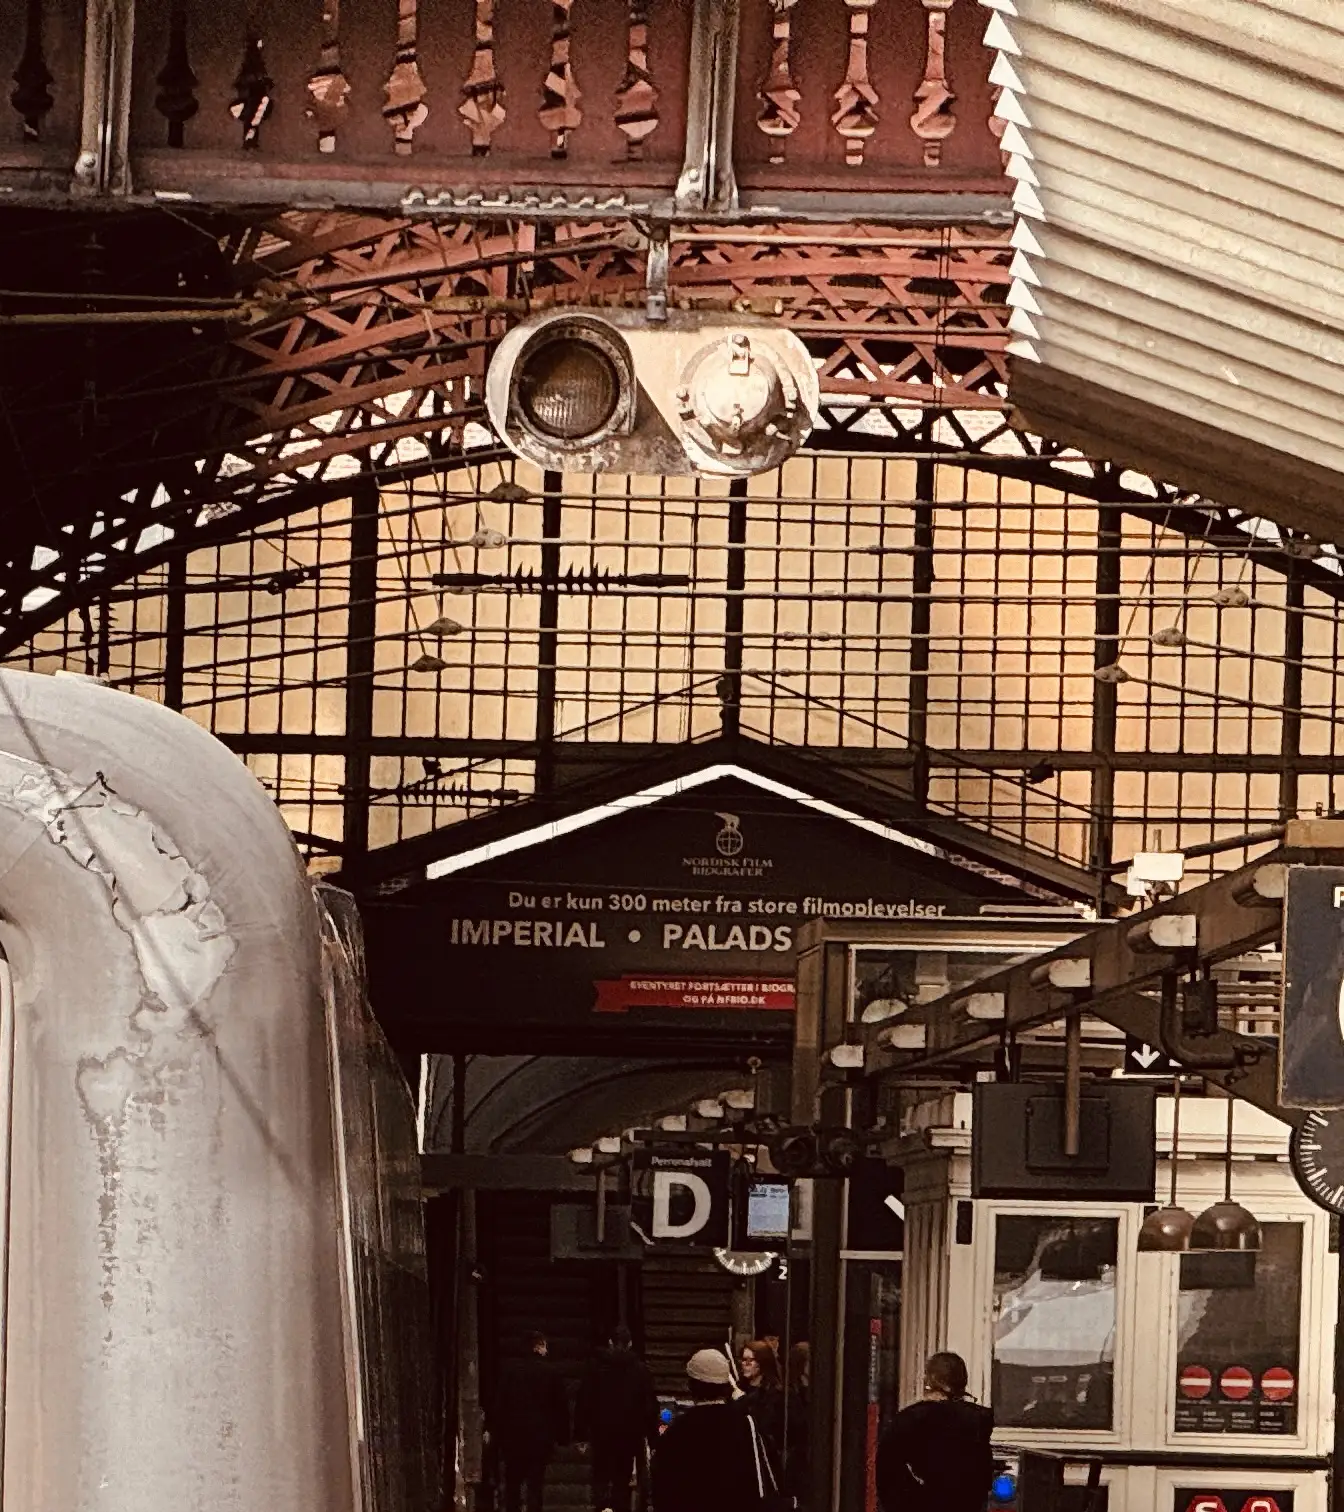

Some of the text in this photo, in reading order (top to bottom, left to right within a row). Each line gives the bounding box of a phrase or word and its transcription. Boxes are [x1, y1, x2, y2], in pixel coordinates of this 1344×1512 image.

[682, 856, 774, 869] NORDISK FILM
[508, 891, 947, 918] Du er kun 300 meter fra store filmoplevelser
[450, 919, 793, 952] IMPERIAL PALADS
[761, 983, 796, 993] BIOGR
[652, 1171, 712, 1239] D
[778, 1265, 788, 1280] 2
